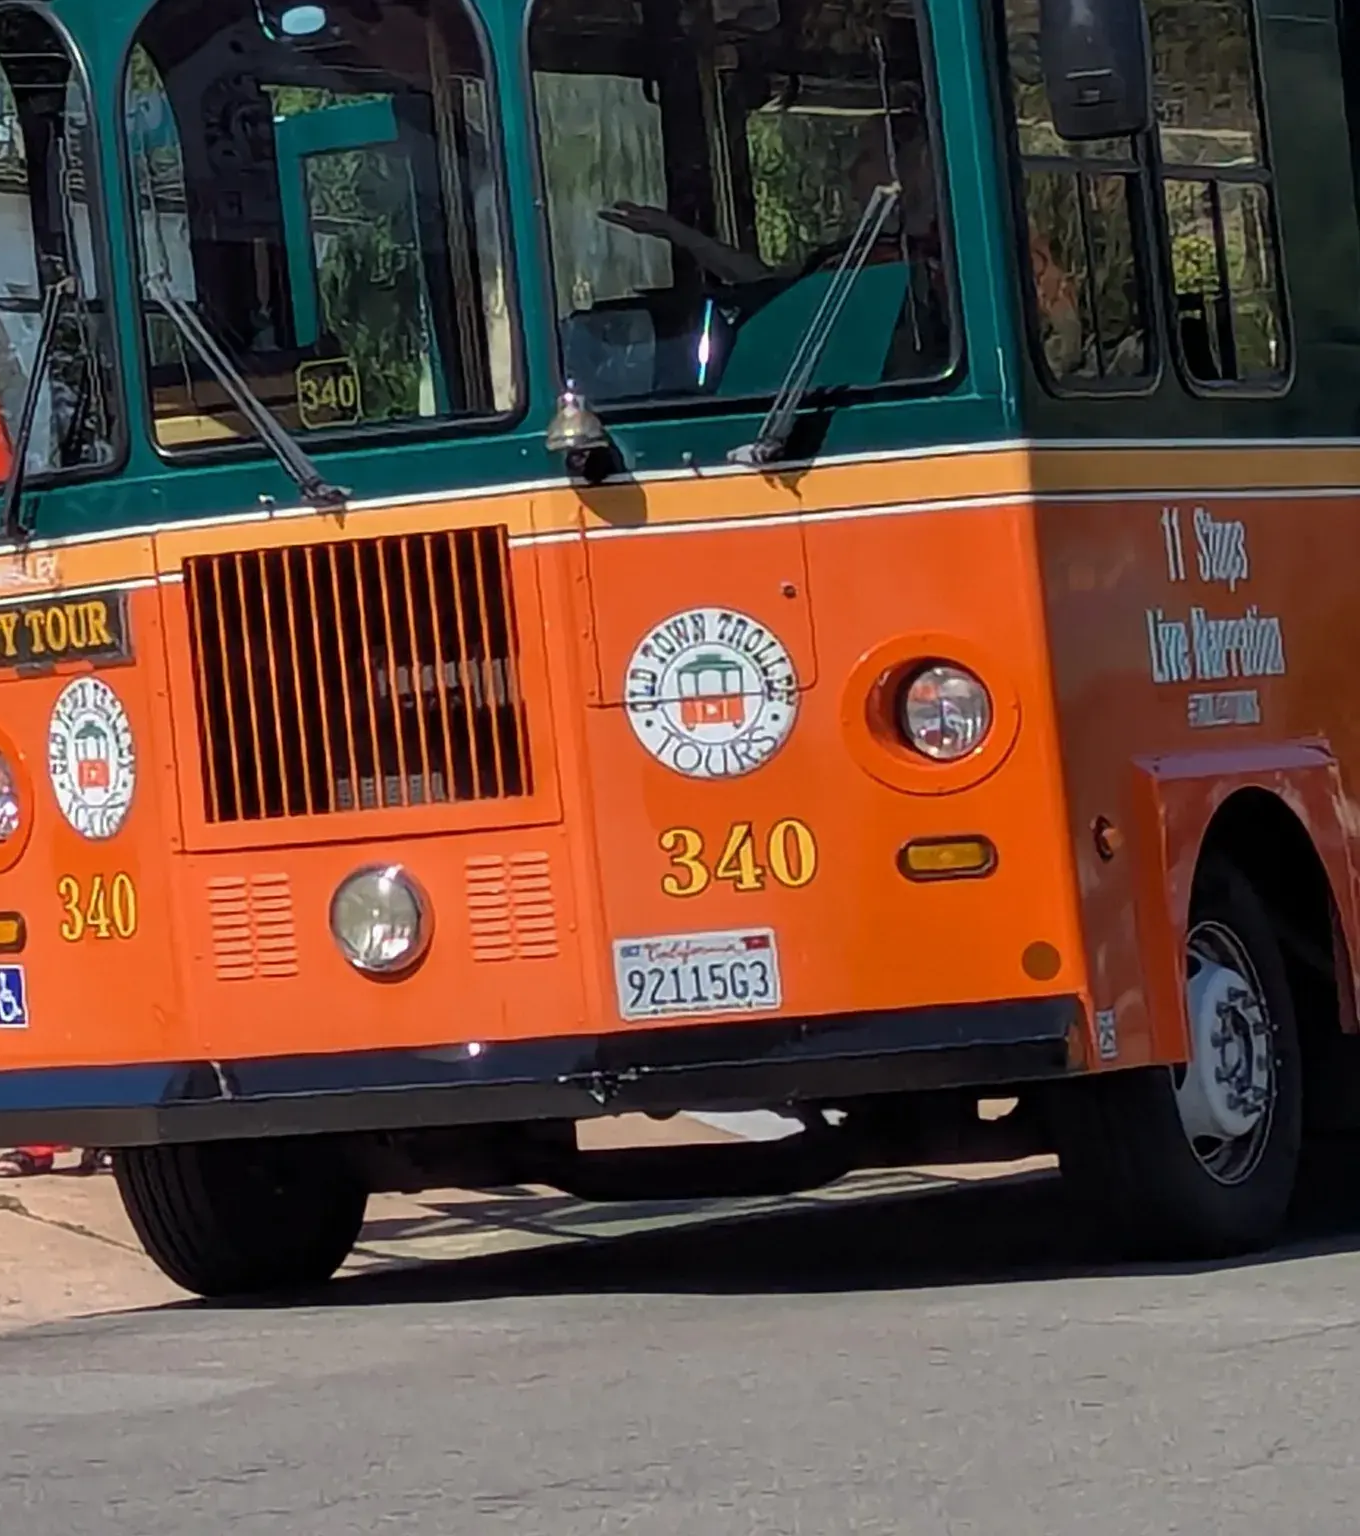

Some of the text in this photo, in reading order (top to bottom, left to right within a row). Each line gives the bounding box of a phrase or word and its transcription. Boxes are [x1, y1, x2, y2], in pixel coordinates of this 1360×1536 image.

[300, 376, 356, 410] 340
[1193, 507, 1248, 592] Stops
[24, 600, 114, 653] TOUR
[1146, 608, 1191, 683] Live
[629, 613, 794, 713] OLD TOWN TROLLEY
[657, 725, 778, 777] TOURS
[660, 818, 818, 898] 340
[57, 872, 138, 942] 340
[627, 961, 770, 1009] 92115G3
